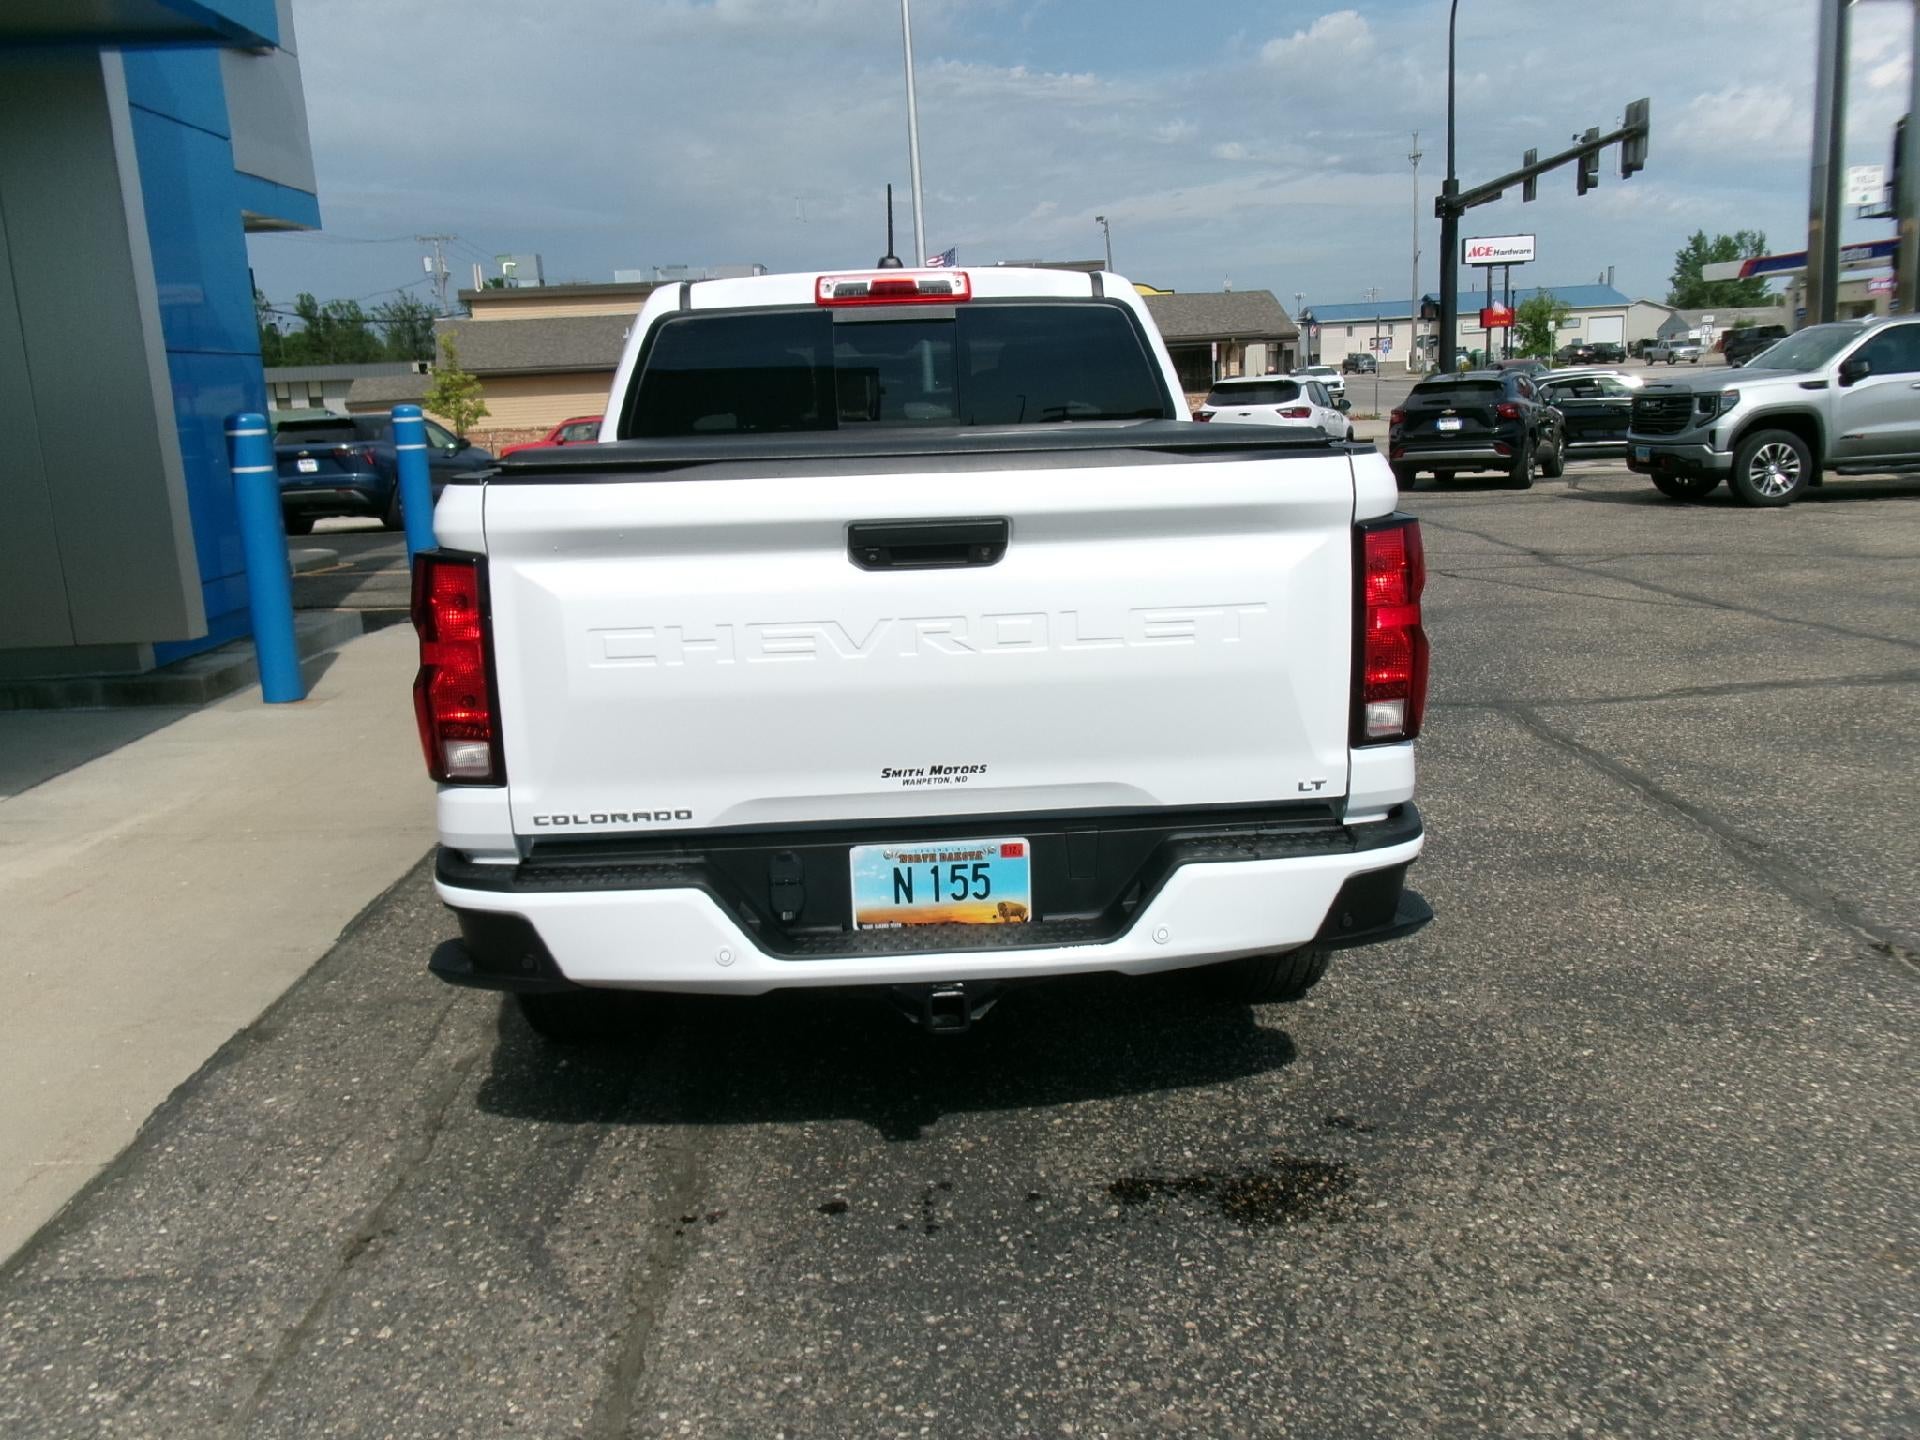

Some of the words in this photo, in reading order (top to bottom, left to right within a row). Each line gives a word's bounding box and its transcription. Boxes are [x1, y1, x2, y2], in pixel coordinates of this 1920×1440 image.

[1467, 246, 1493, 257] ACE
[1493, 248, 1532, 257] Hardware
[587, 602, 1268, 668] CHEVROLET
[881, 767, 924, 779] SMITH
[929, 764, 988, 776] MOTORS
[954, 775, 968, 783] ND
[1298, 780, 1327, 792] LT
[533, 810, 693, 826] COLORADO
[899, 852, 936, 863] NORTH
[939, 850, 983, 862] DAKOTA
[893, 866, 913, 904] N
[930, 863, 991, 902] 155
